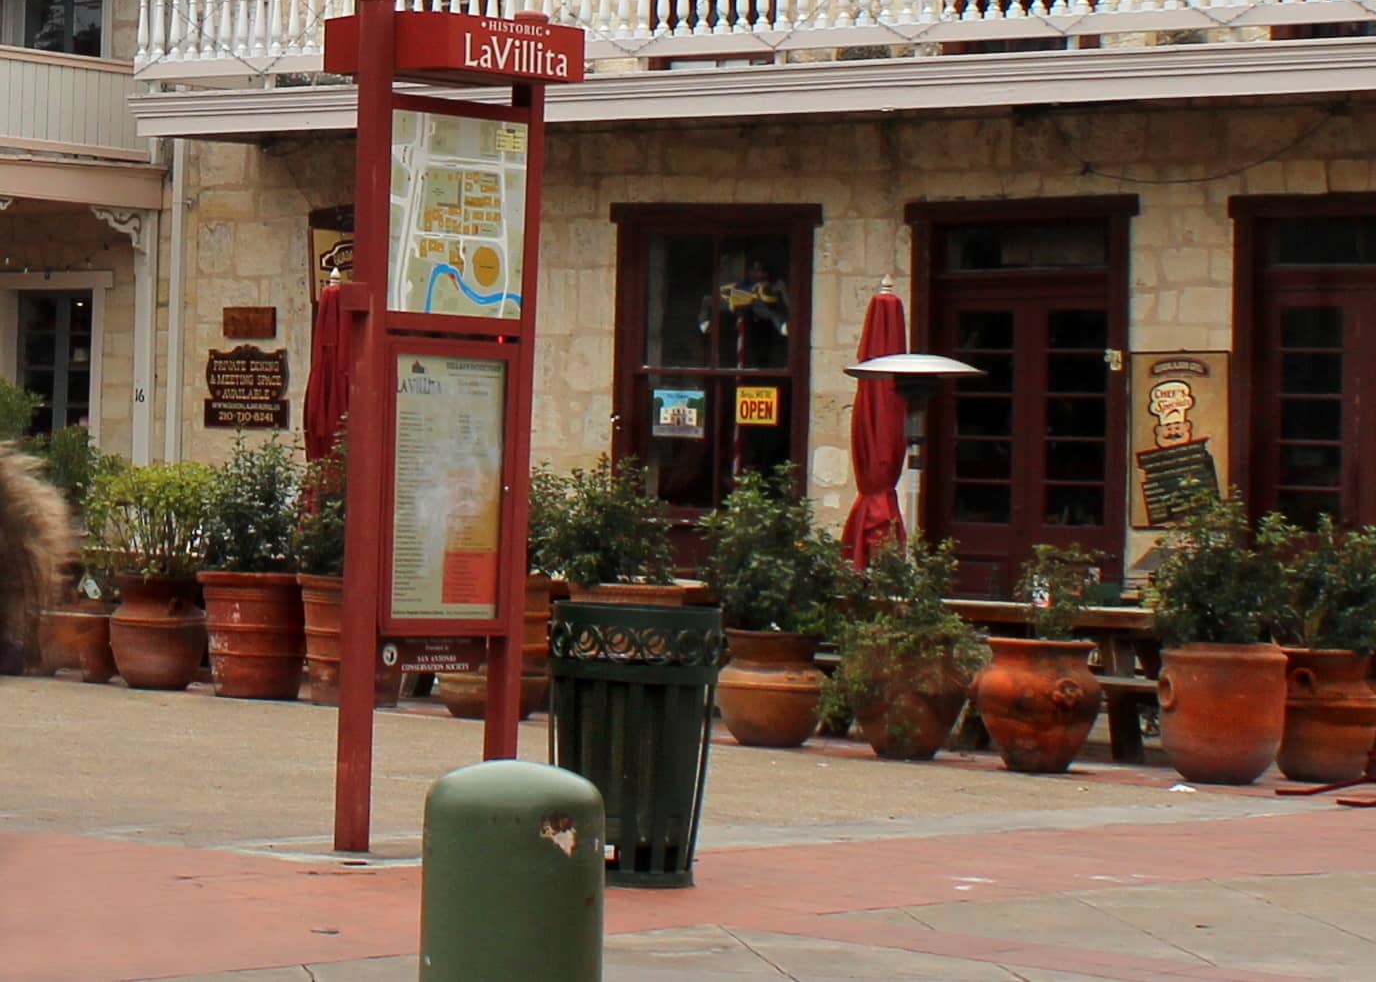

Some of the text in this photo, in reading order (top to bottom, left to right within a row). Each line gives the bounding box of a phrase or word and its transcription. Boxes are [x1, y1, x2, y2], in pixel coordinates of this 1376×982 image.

[488, 20, 543, 36] HISTORIC
[465, 32, 568, 77] LaVillita
[212, 360, 247, 372] PRIVATE
[135, 387, 145, 403] 16
[222, 388, 270, 400] AVAILABLE
[740, 400, 773, 420] OPEN
